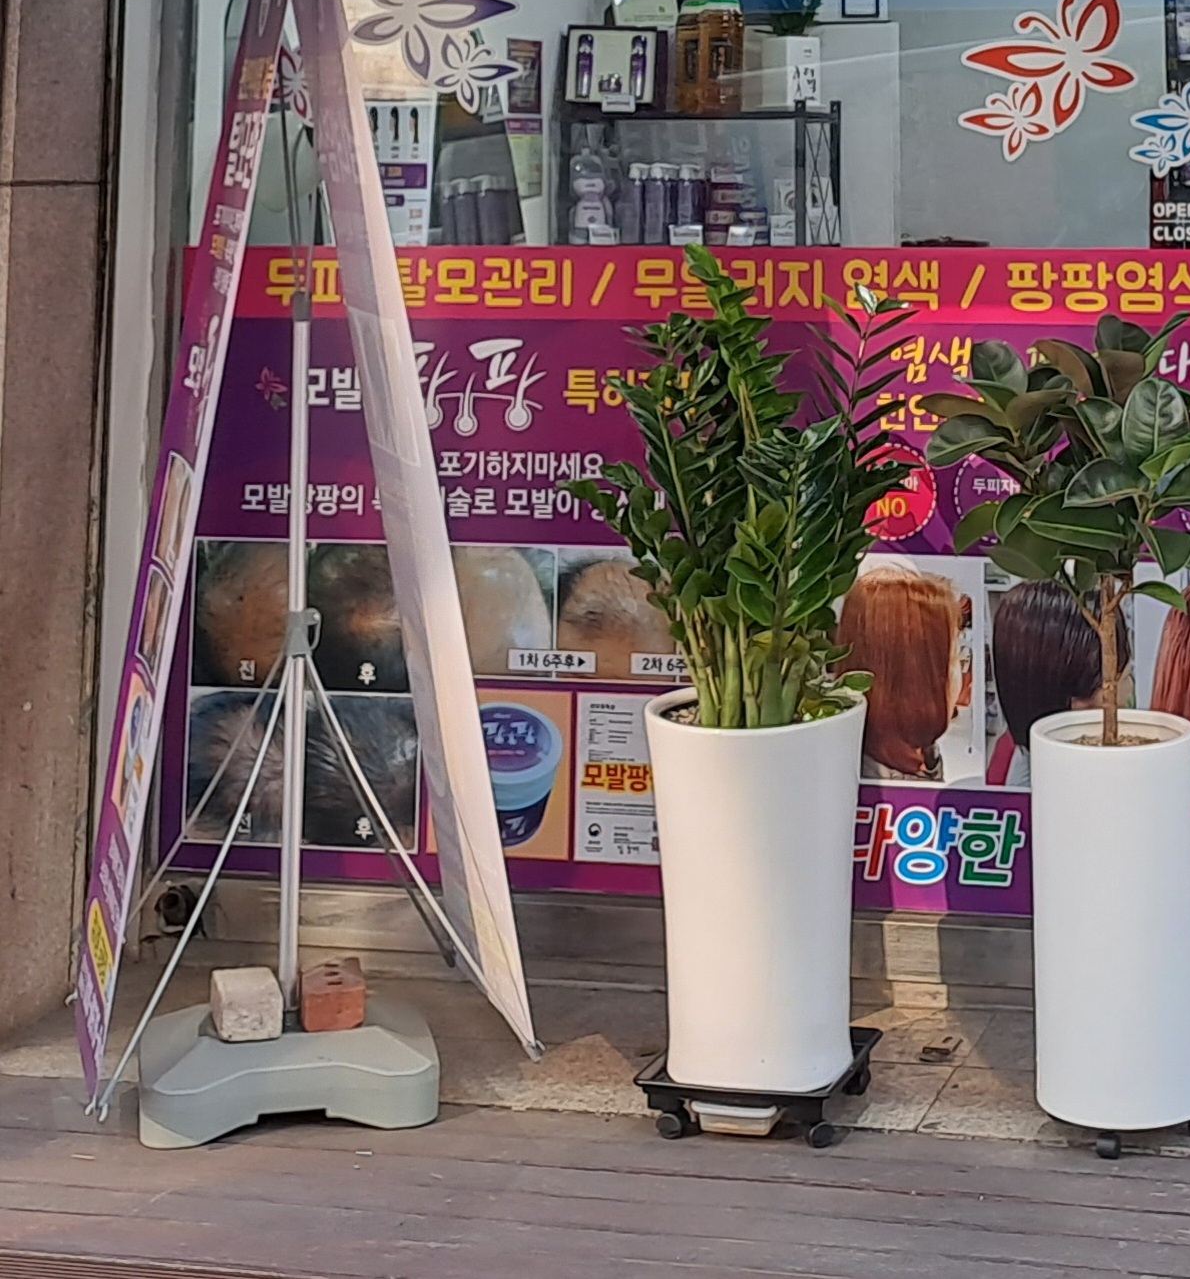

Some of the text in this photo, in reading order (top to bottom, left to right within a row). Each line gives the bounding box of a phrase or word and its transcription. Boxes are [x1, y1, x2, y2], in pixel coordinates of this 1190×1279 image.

[438, 451, 604, 483] 포기하지마세요
[876, 497, 907, 519] NO
[518, 653, 538, 668] 1차
[642, 657, 663, 671] 2차
[357, 663, 376, 685] 후
[581, 763, 653, 793] 모발팡
